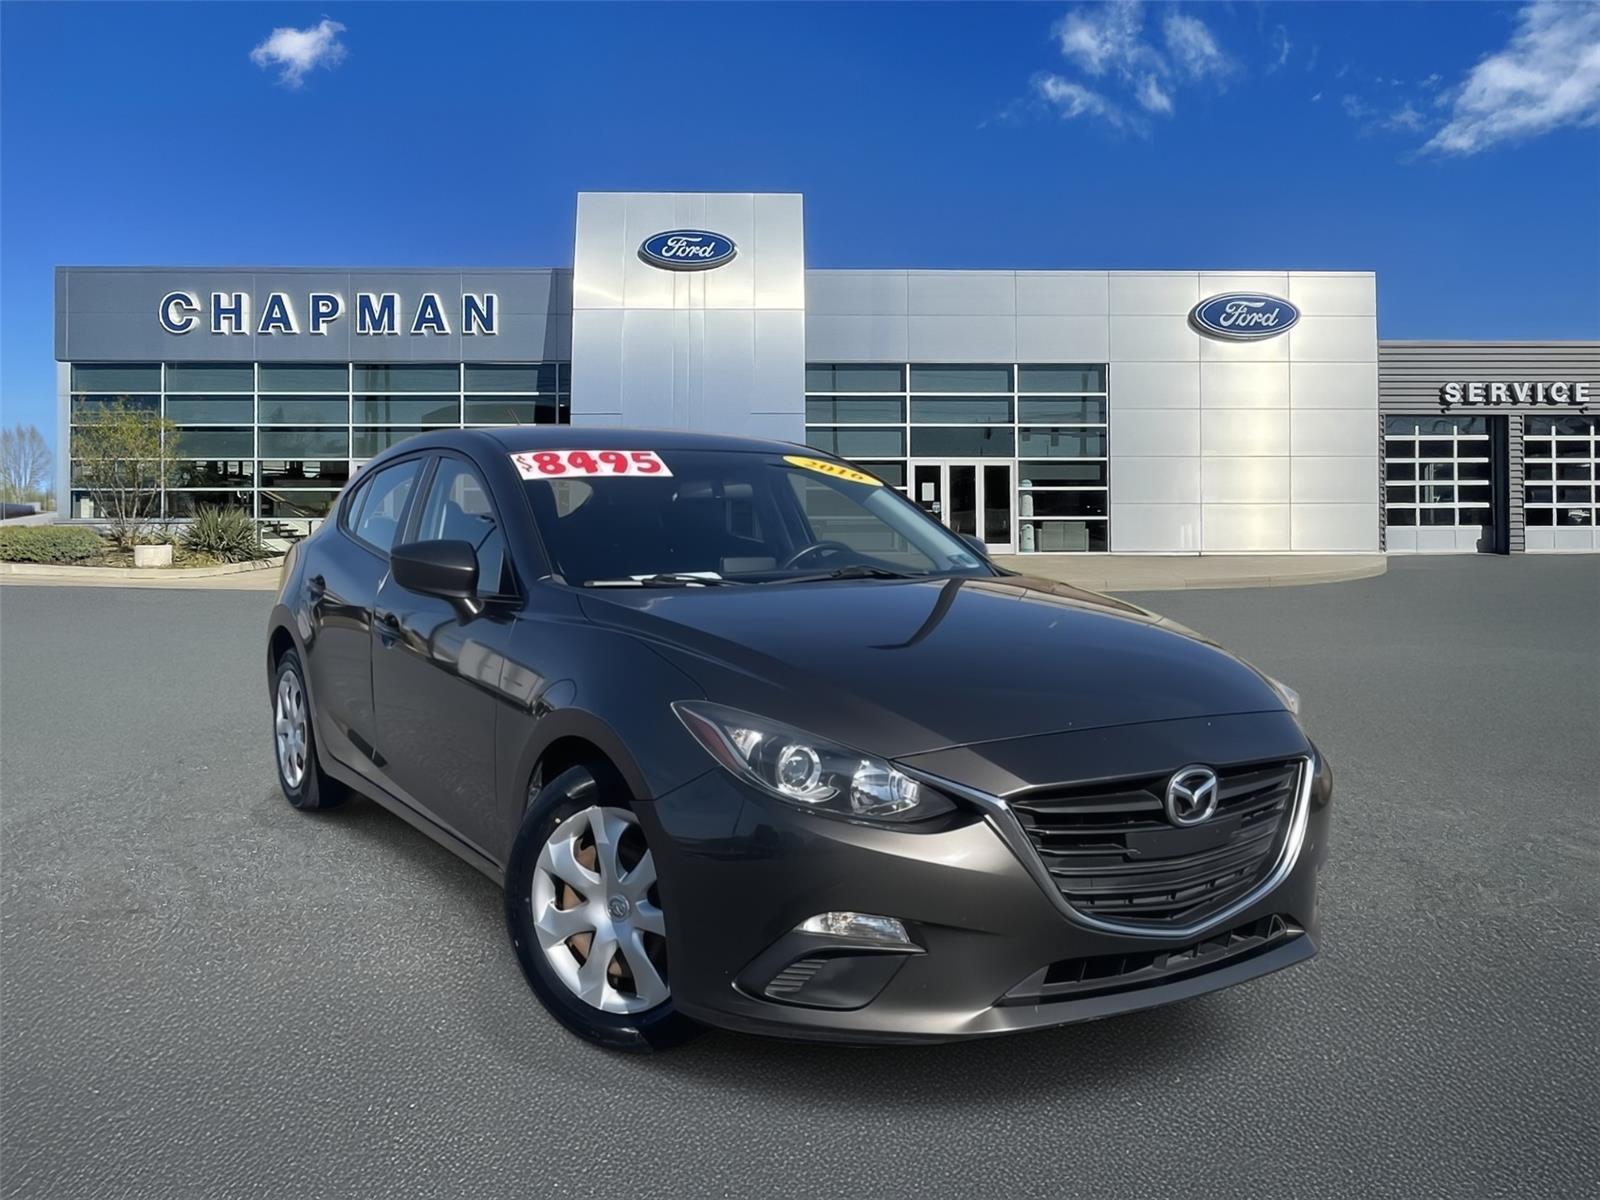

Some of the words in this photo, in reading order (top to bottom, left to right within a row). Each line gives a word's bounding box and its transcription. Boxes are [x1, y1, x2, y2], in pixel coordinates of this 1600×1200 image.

[661, 236, 715, 257] Ford
[159, 291, 499, 336] CHAPMAN
[1219, 301, 1280, 327] Ford
[1444, 382, 1591, 403] SERVICE
[516, 451, 662, 475] $8495
